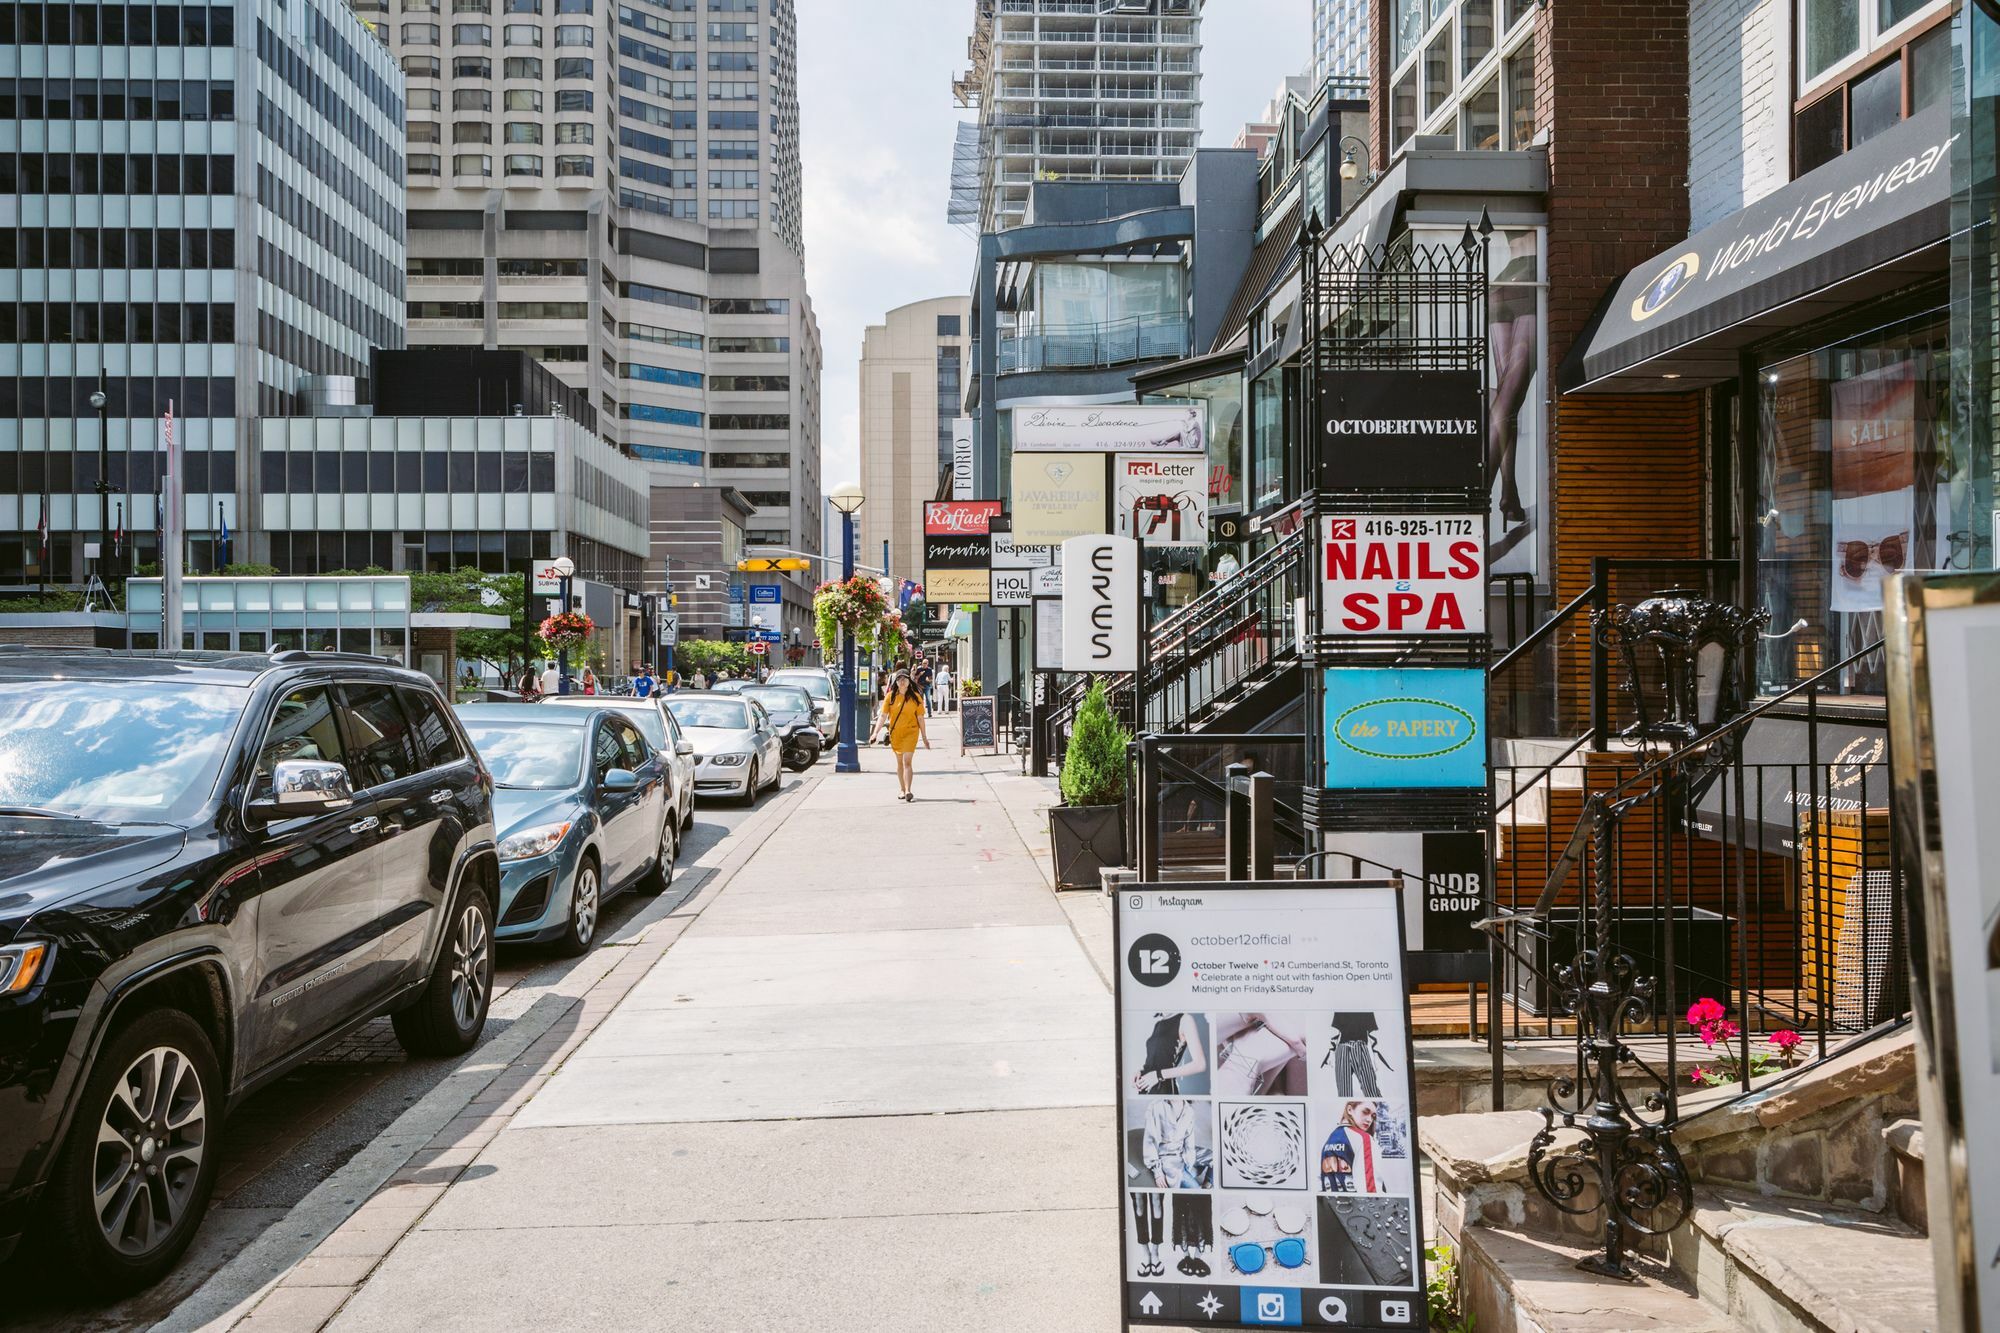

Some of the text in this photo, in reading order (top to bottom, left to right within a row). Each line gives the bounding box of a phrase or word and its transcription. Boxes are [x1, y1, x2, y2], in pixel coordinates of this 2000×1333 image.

[1705, 132, 1961, 282] World Eyewear
[1023, 409, 1140, 428] Divine Decadence
[1326, 419, 1477, 434] OCTOBERTWELVE
[954, 438, 971, 489] FIORIO
[927, 507, 1001, 531] Raffaell
[1365, 520, 1472, 535] 416-925-1772
[995, 541, 1047, 557] bespoke
[1326, 541, 1480, 580] NAILS
[1208, 572, 1228, 580] SALE
[1341, 592, 1466, 632] SPA
[1350, 719, 1460, 738] the PAPERY
[1429, 873, 1480, 895] NDB
[1158, 896, 1204, 910] Instagram
[1429, 898, 1481, 912] GROUP
[1190, 934, 1292, 946] october12official
[1139, 949, 1170, 973] 12
[1191, 961, 1226, 970] October
[1228, 961, 1259, 970] Twelve
[1355, 961, 1389, 969] Toronto
[1201, 973, 1243, 982] Celebrate
[1252, 973, 1274, 983] night
[1291, 973, 1310, 981] with
[1312, 973, 1344, 981] fashion
[1345, 972, 1371, 983] Open
[1372, 972, 1394, 981] Until
[1191, 985, 1229, 994] Midnight
[1244, 984, 1315, 995] Friday&Saturday
